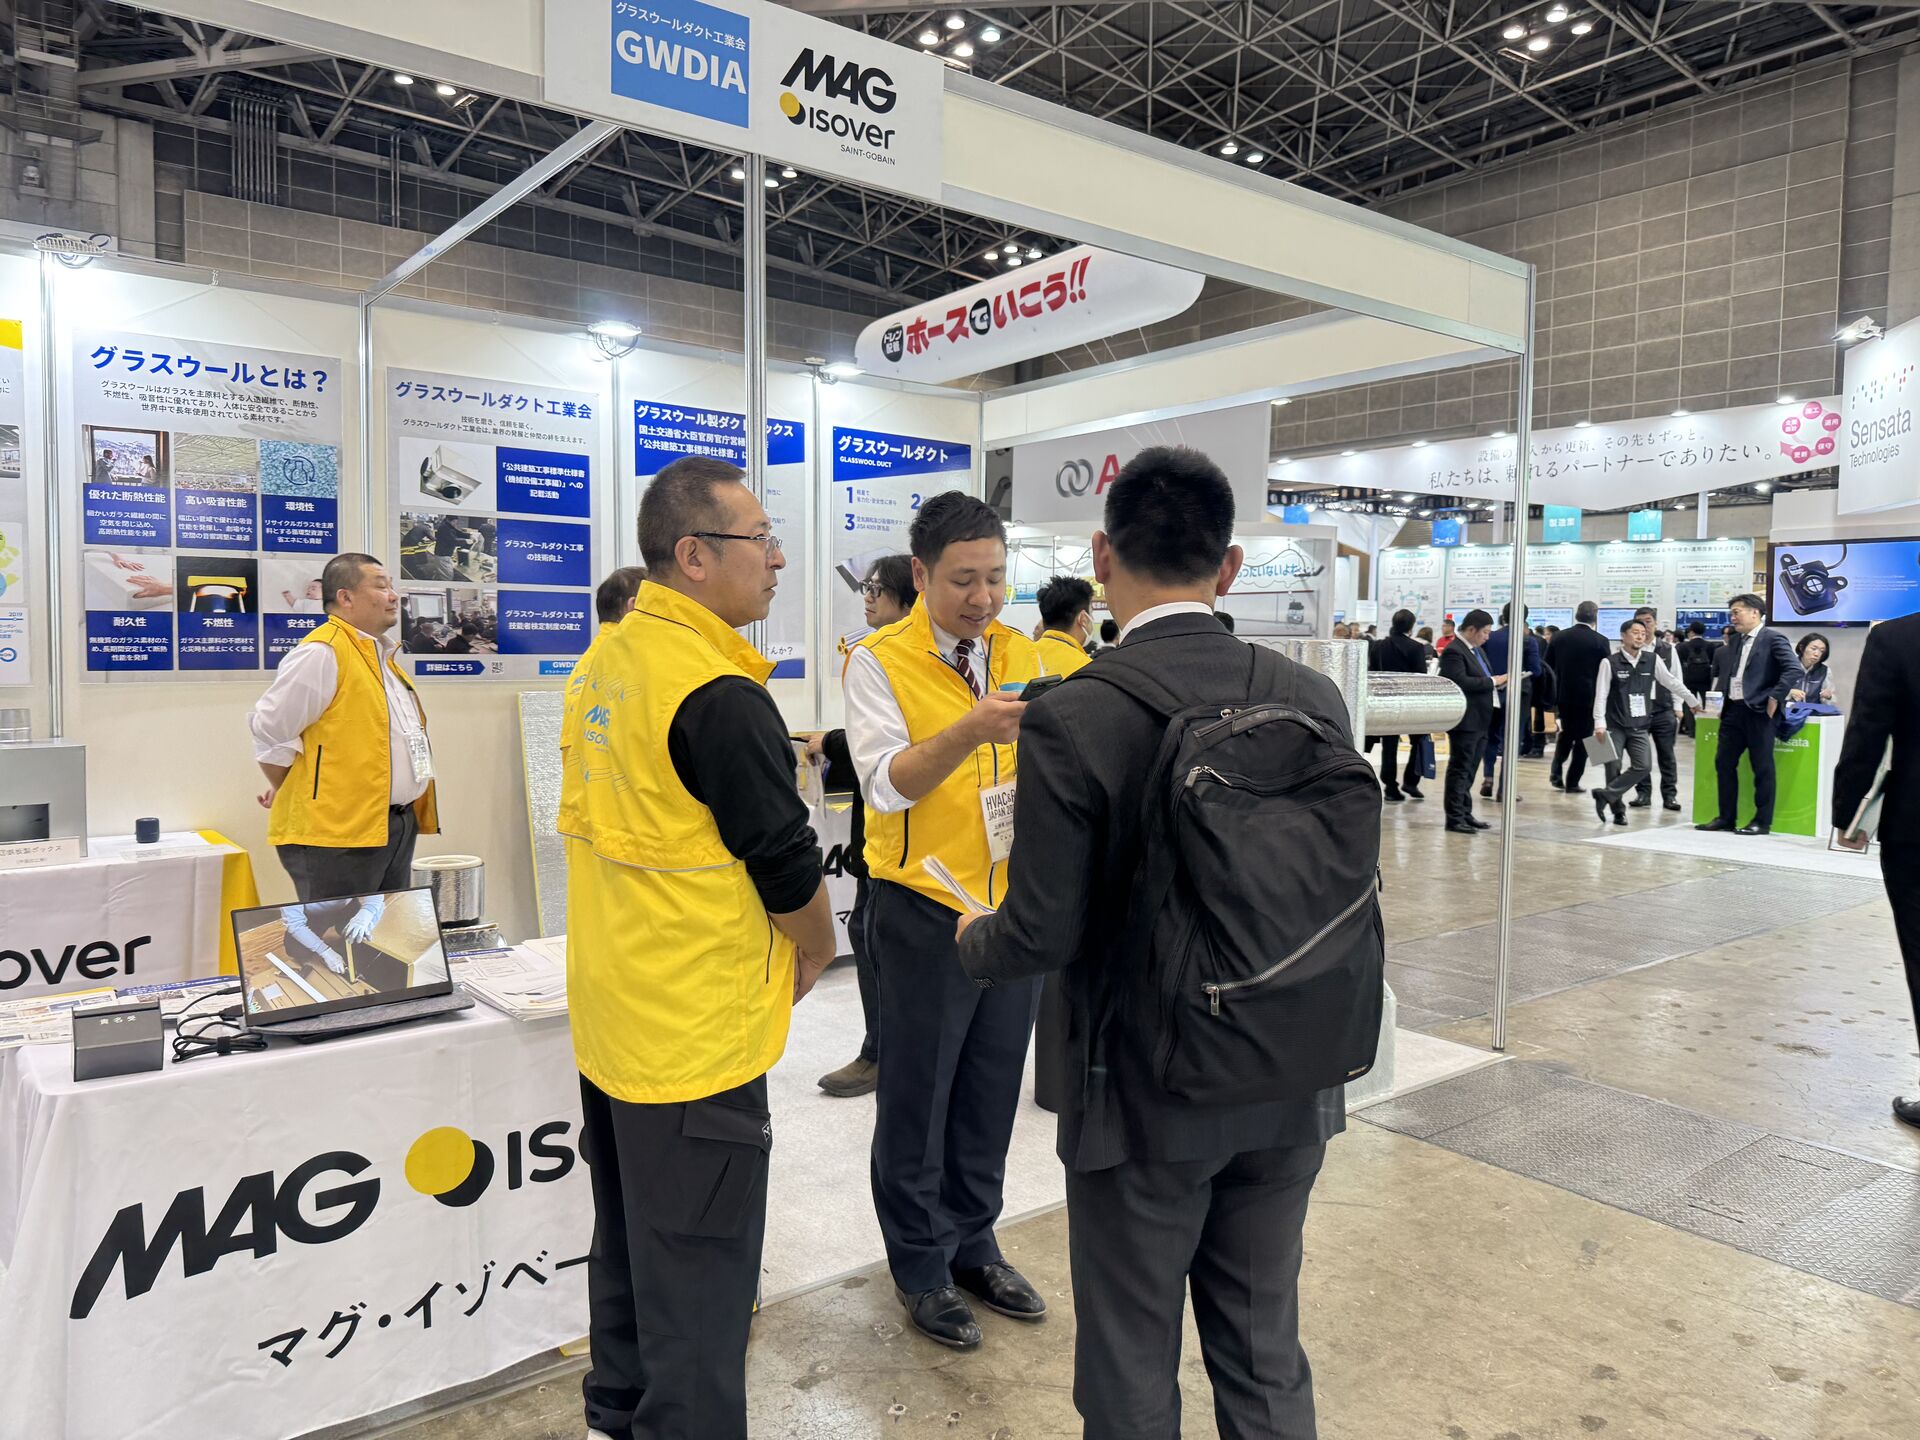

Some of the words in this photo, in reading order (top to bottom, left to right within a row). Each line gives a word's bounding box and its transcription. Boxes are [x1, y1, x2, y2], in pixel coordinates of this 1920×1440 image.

[616, 1, 746, 52] グラスウールダクト工業会
[616, 30, 747, 94] GWDIA
[780, 47, 897, 114] MAG
[840, 144, 896, 166] SAINT-GOBAIN
[90, 345, 328, 393] グラスウールとは？
[103, 389, 318, 419] 不燃性、吸音性に優れており、人体に安全であることから
[395, 381, 593, 420] グラスウールダクト工業会
[141, 403, 286, 425] 世界中で長年使用されている素材です。
[1850, 408, 1912, 449] Sensata
[838, 435, 948, 463] グラスウールダクト
[1850, 443, 1900, 469] Technologies
[839, 456, 876, 466] GLASSWOOL
[88, 489, 166, 503] 優れた断熱性能
[185, 495, 247, 508] 高い吸音性能
[846, 486, 854, 504] 1
[911, 493, 921, 510] 2
[285, 501, 315, 512] 環境性
[844, 513, 855, 531] 3
[504, 540, 584, 552] グラスウールダクト工事
[526, 553, 564, 563] の技術向上
[113, 616, 147, 627] 耐久性
[202, 617, 234, 628] 不燃性
[287, 618, 317, 628] 安全性
[504, 609, 585, 620] グラスウールダクト工事
[552, 661, 577, 669] GWDI
[507, 1120, 592, 1190] IS
[70, 1150, 381, 1320] MAG
